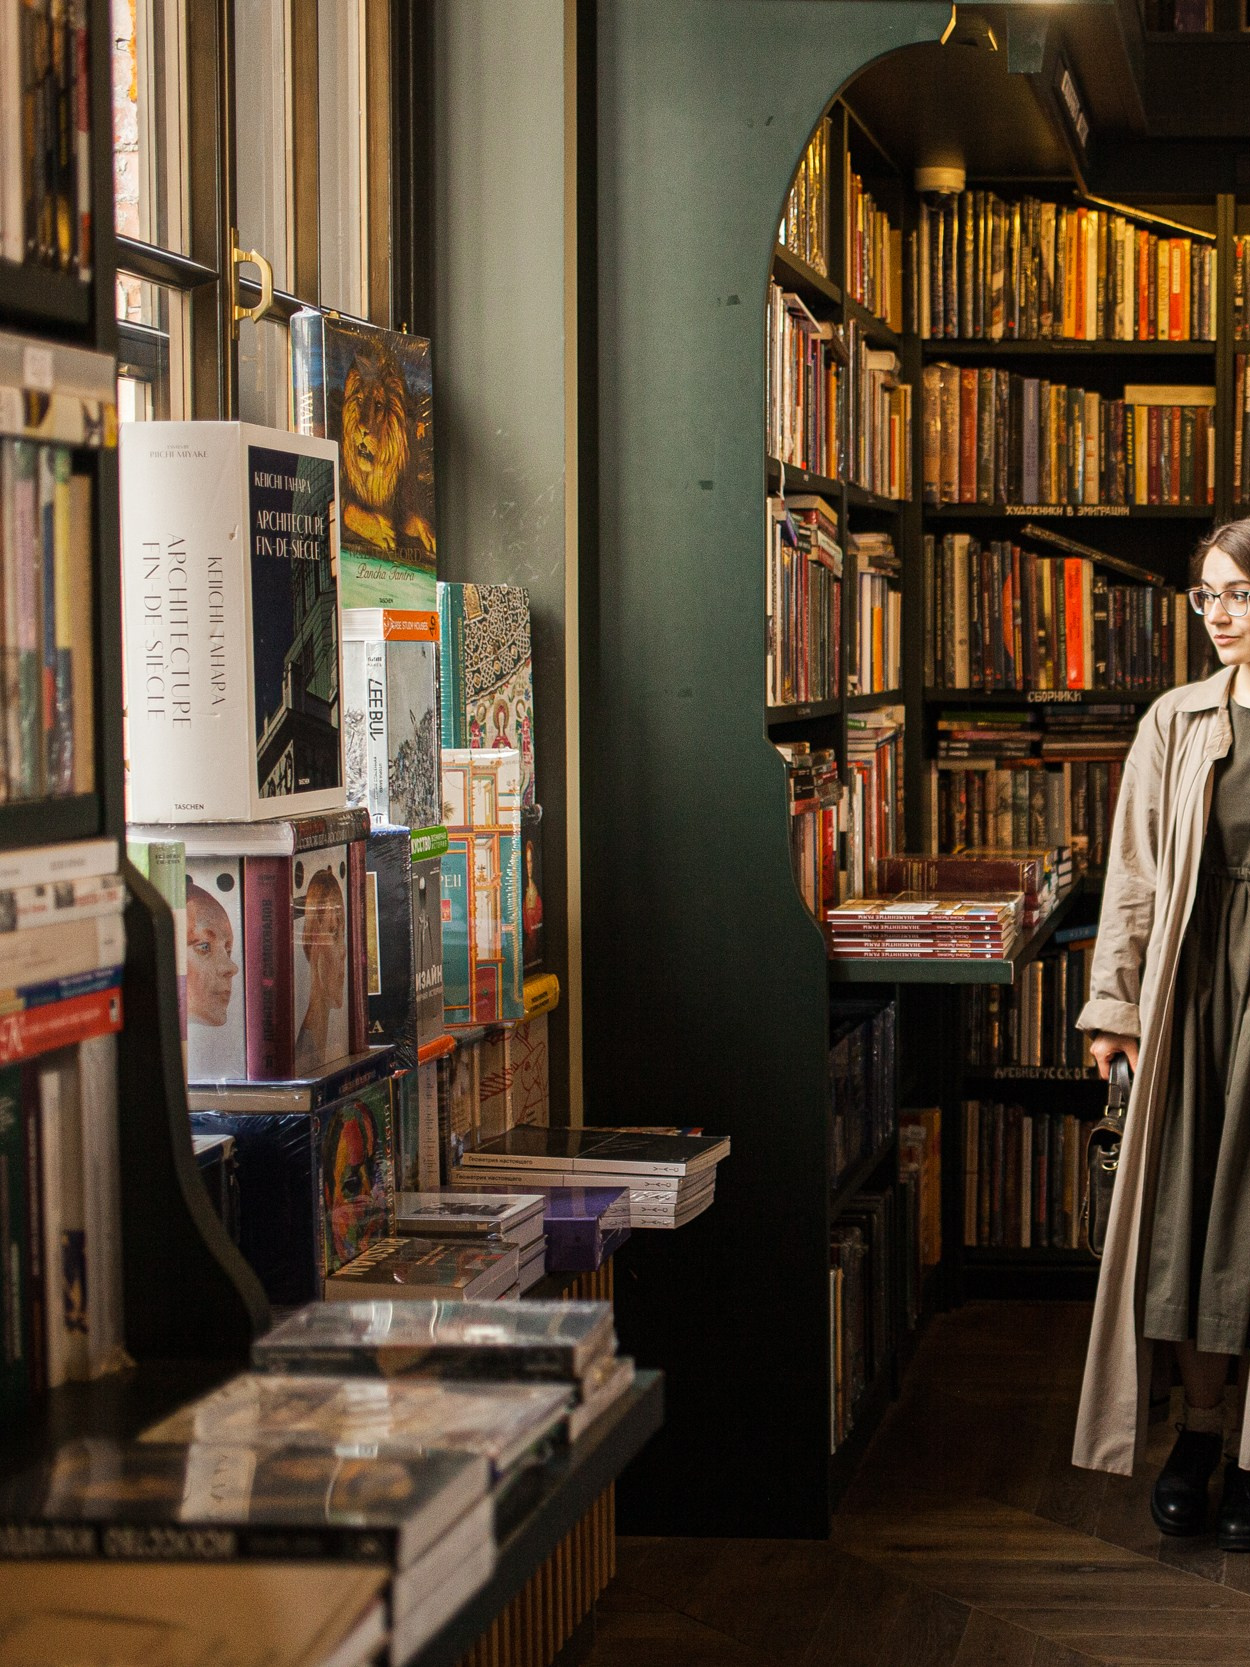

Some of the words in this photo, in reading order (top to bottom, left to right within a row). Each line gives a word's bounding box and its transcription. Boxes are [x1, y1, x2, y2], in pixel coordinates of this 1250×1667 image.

[254, 471, 283, 490] KEIICHI
[1006, 506, 1063, 516] ХУДОЖНИКИ
[1066, 507, 1074, 517] В
[1077, 506, 1130, 517] ЭМИГРАЦИИ
[256, 510, 325, 536] ARCHITECTURE
[356, 563, 386, 580] Pancha
[388, 565, 415, 581] Tantra
[207, 557, 225, 623] KEIICHI
[167, 533, 192, 729] ARCHITECTURE
[209, 634, 226, 706] TAHARA
[368, 678, 384, 712] LEE
[1027, 690, 1082, 703] СБОРНИКИ
[368, 714, 384, 742] BUL
[174, 803, 205, 811] TASCHEN
[441, 874, 462, 888] PEII
[416, 964, 443, 991] ИЗАЙН
[468, 1156, 498, 1166] Геометрия
[499, 1158, 533, 1167] настоящего
[456, 1173, 487, 1183] Геометрия
[487, 1175, 522, 1183] настоящего
